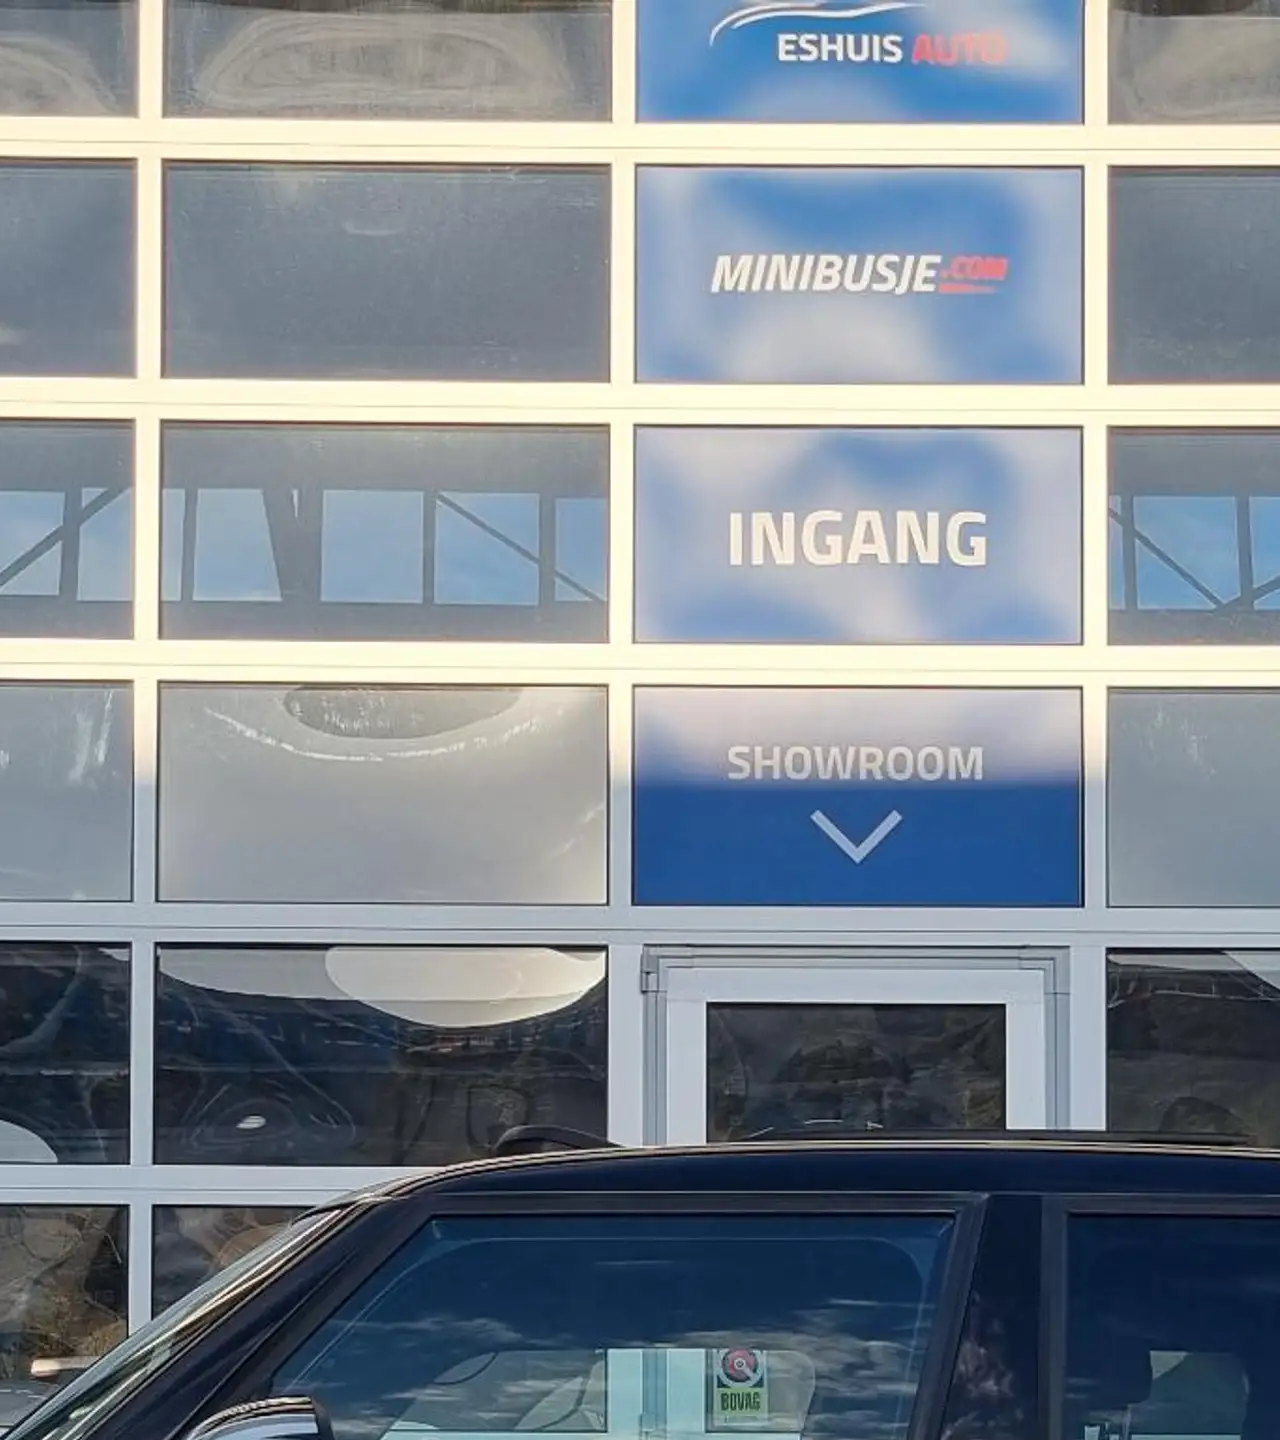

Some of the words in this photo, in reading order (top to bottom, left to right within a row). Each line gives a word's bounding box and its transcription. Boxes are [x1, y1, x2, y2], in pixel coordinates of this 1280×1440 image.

[777, 33, 903, 63] ESHUIS
[729, 510, 987, 566] INGANG
[727, 745, 983, 781] SHOWROOM
[720, 1391, 761, 1411] BOVAG
